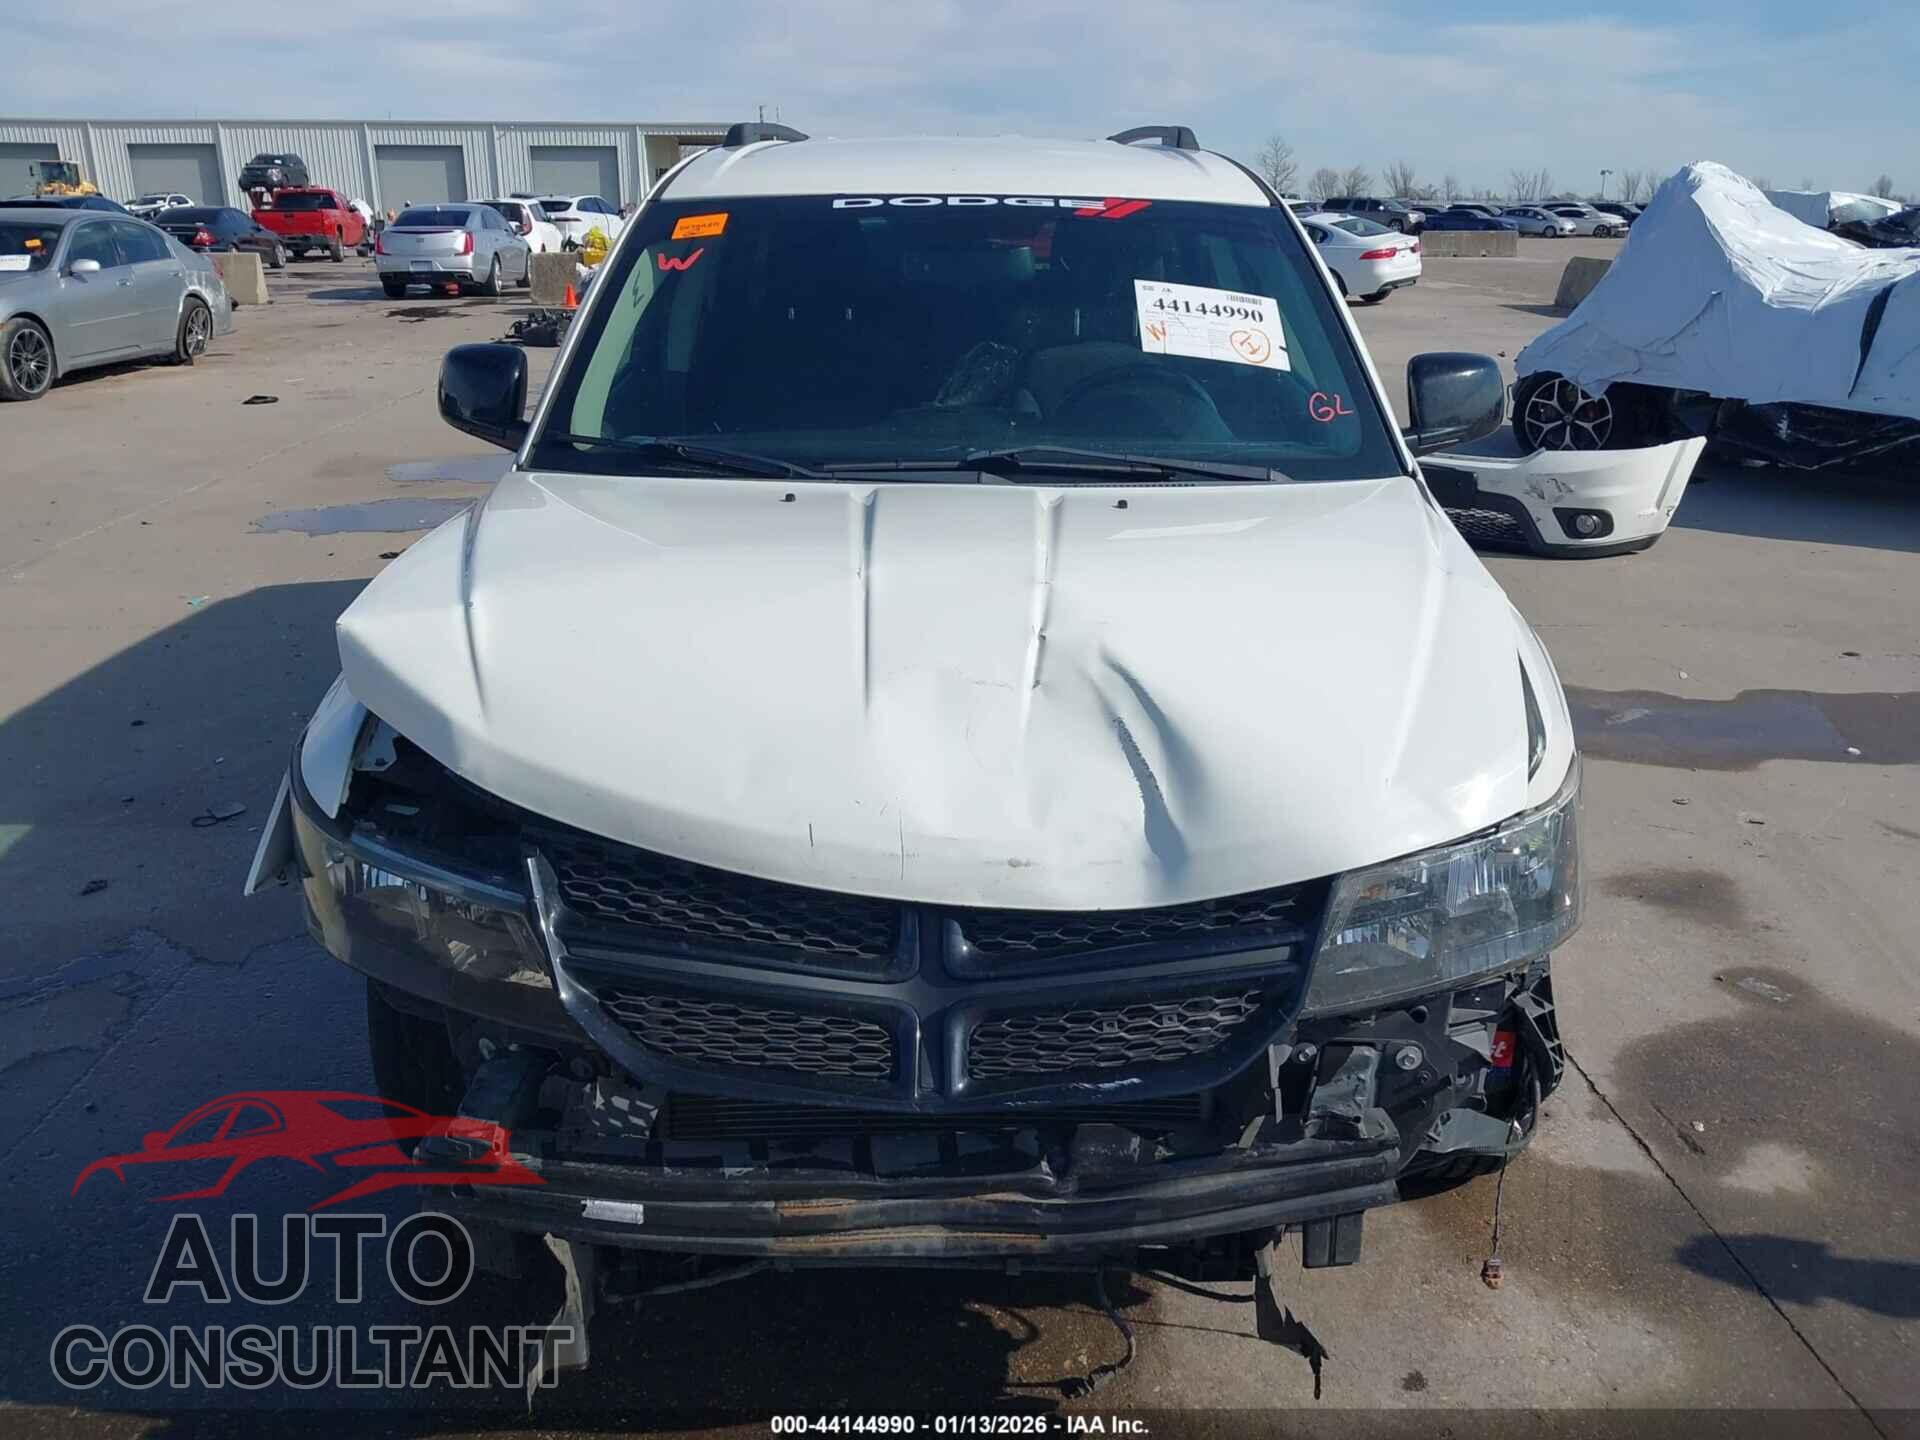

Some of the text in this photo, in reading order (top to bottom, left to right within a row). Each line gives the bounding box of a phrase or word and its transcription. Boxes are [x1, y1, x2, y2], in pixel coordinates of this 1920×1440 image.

[832, 197, 1106, 210] DODGE
[657, 247, 704, 271] W
[1152, 297, 1264, 323] 44144990
[1309, 391, 1353, 422] GL
